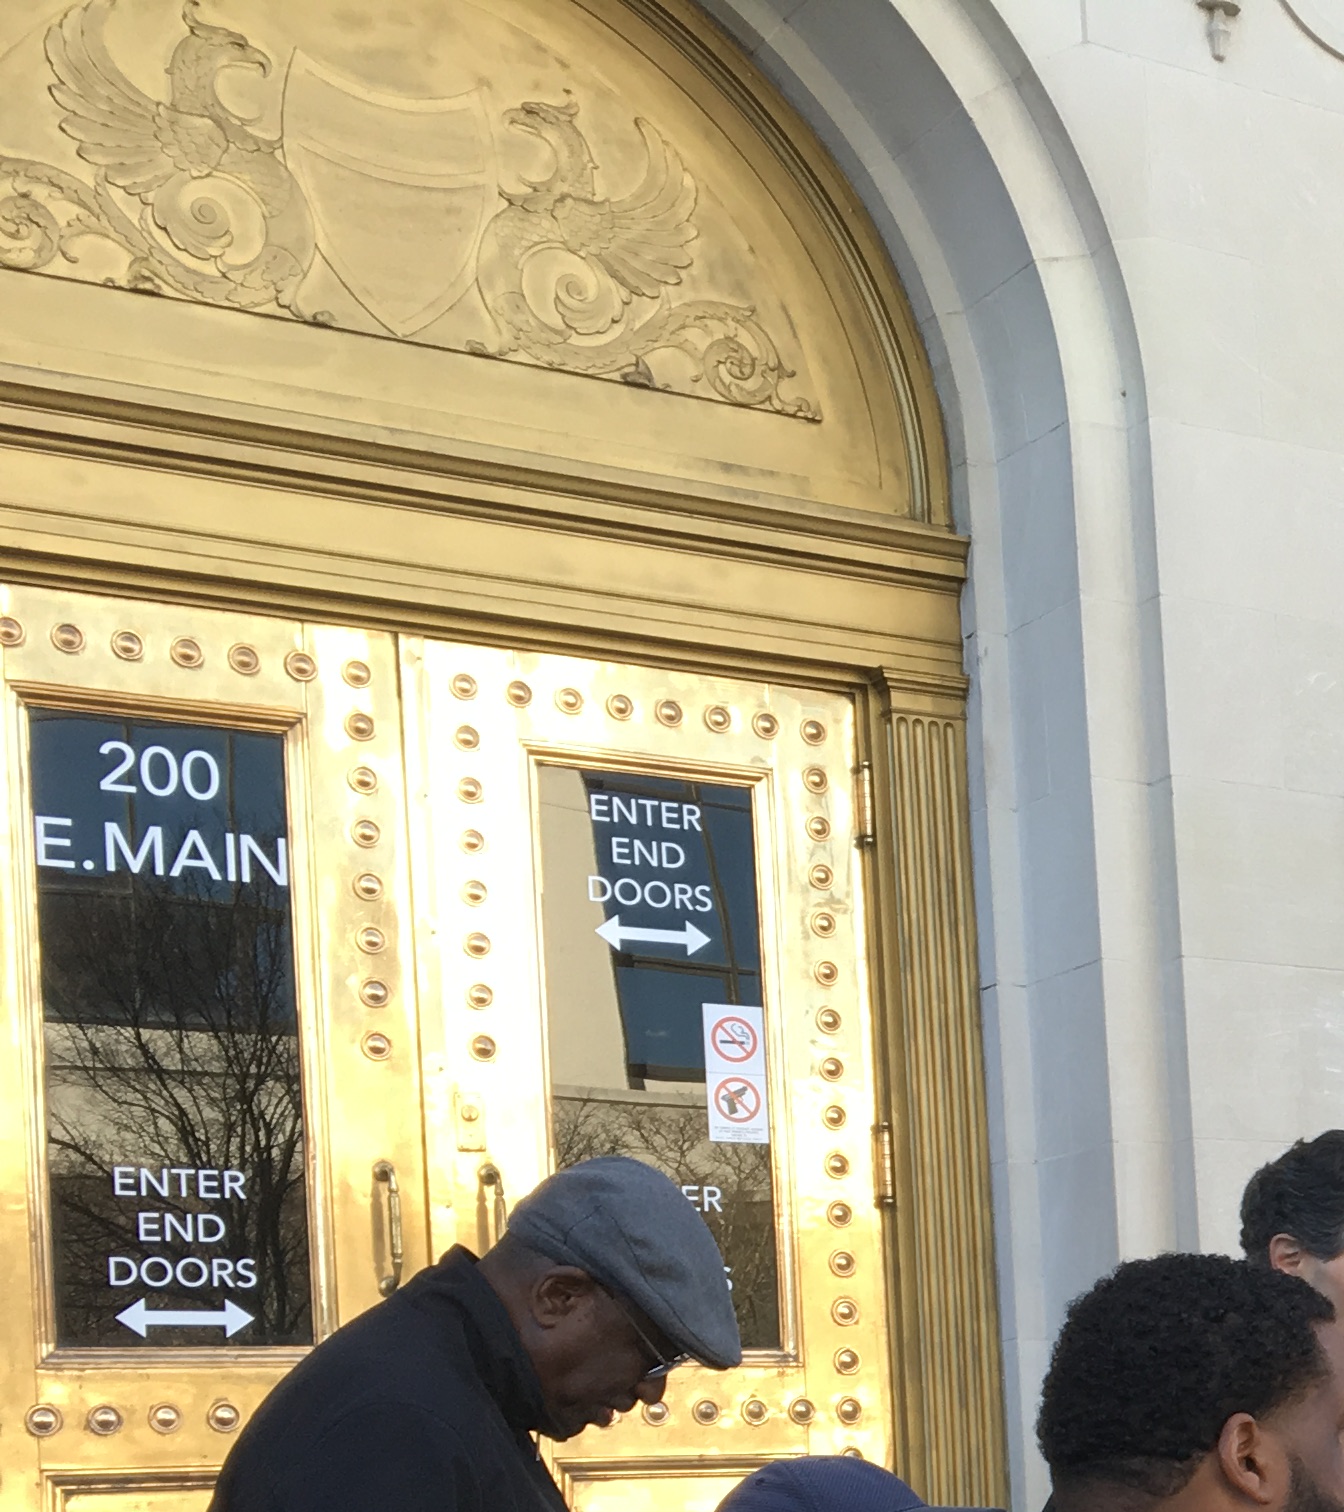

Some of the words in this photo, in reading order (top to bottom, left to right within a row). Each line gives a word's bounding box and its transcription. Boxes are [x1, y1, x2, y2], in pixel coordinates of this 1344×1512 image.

[99, 740, 220, 801] 200
[590, 794, 702, 832] ENTER
[611, 836, 685, 869] END
[588, 875, 713, 912] DOORS
[113, 1166, 247, 1200] ENTER
[138, 1212, 226, 1243] END
[108, 1256, 257, 1288] DOORS
